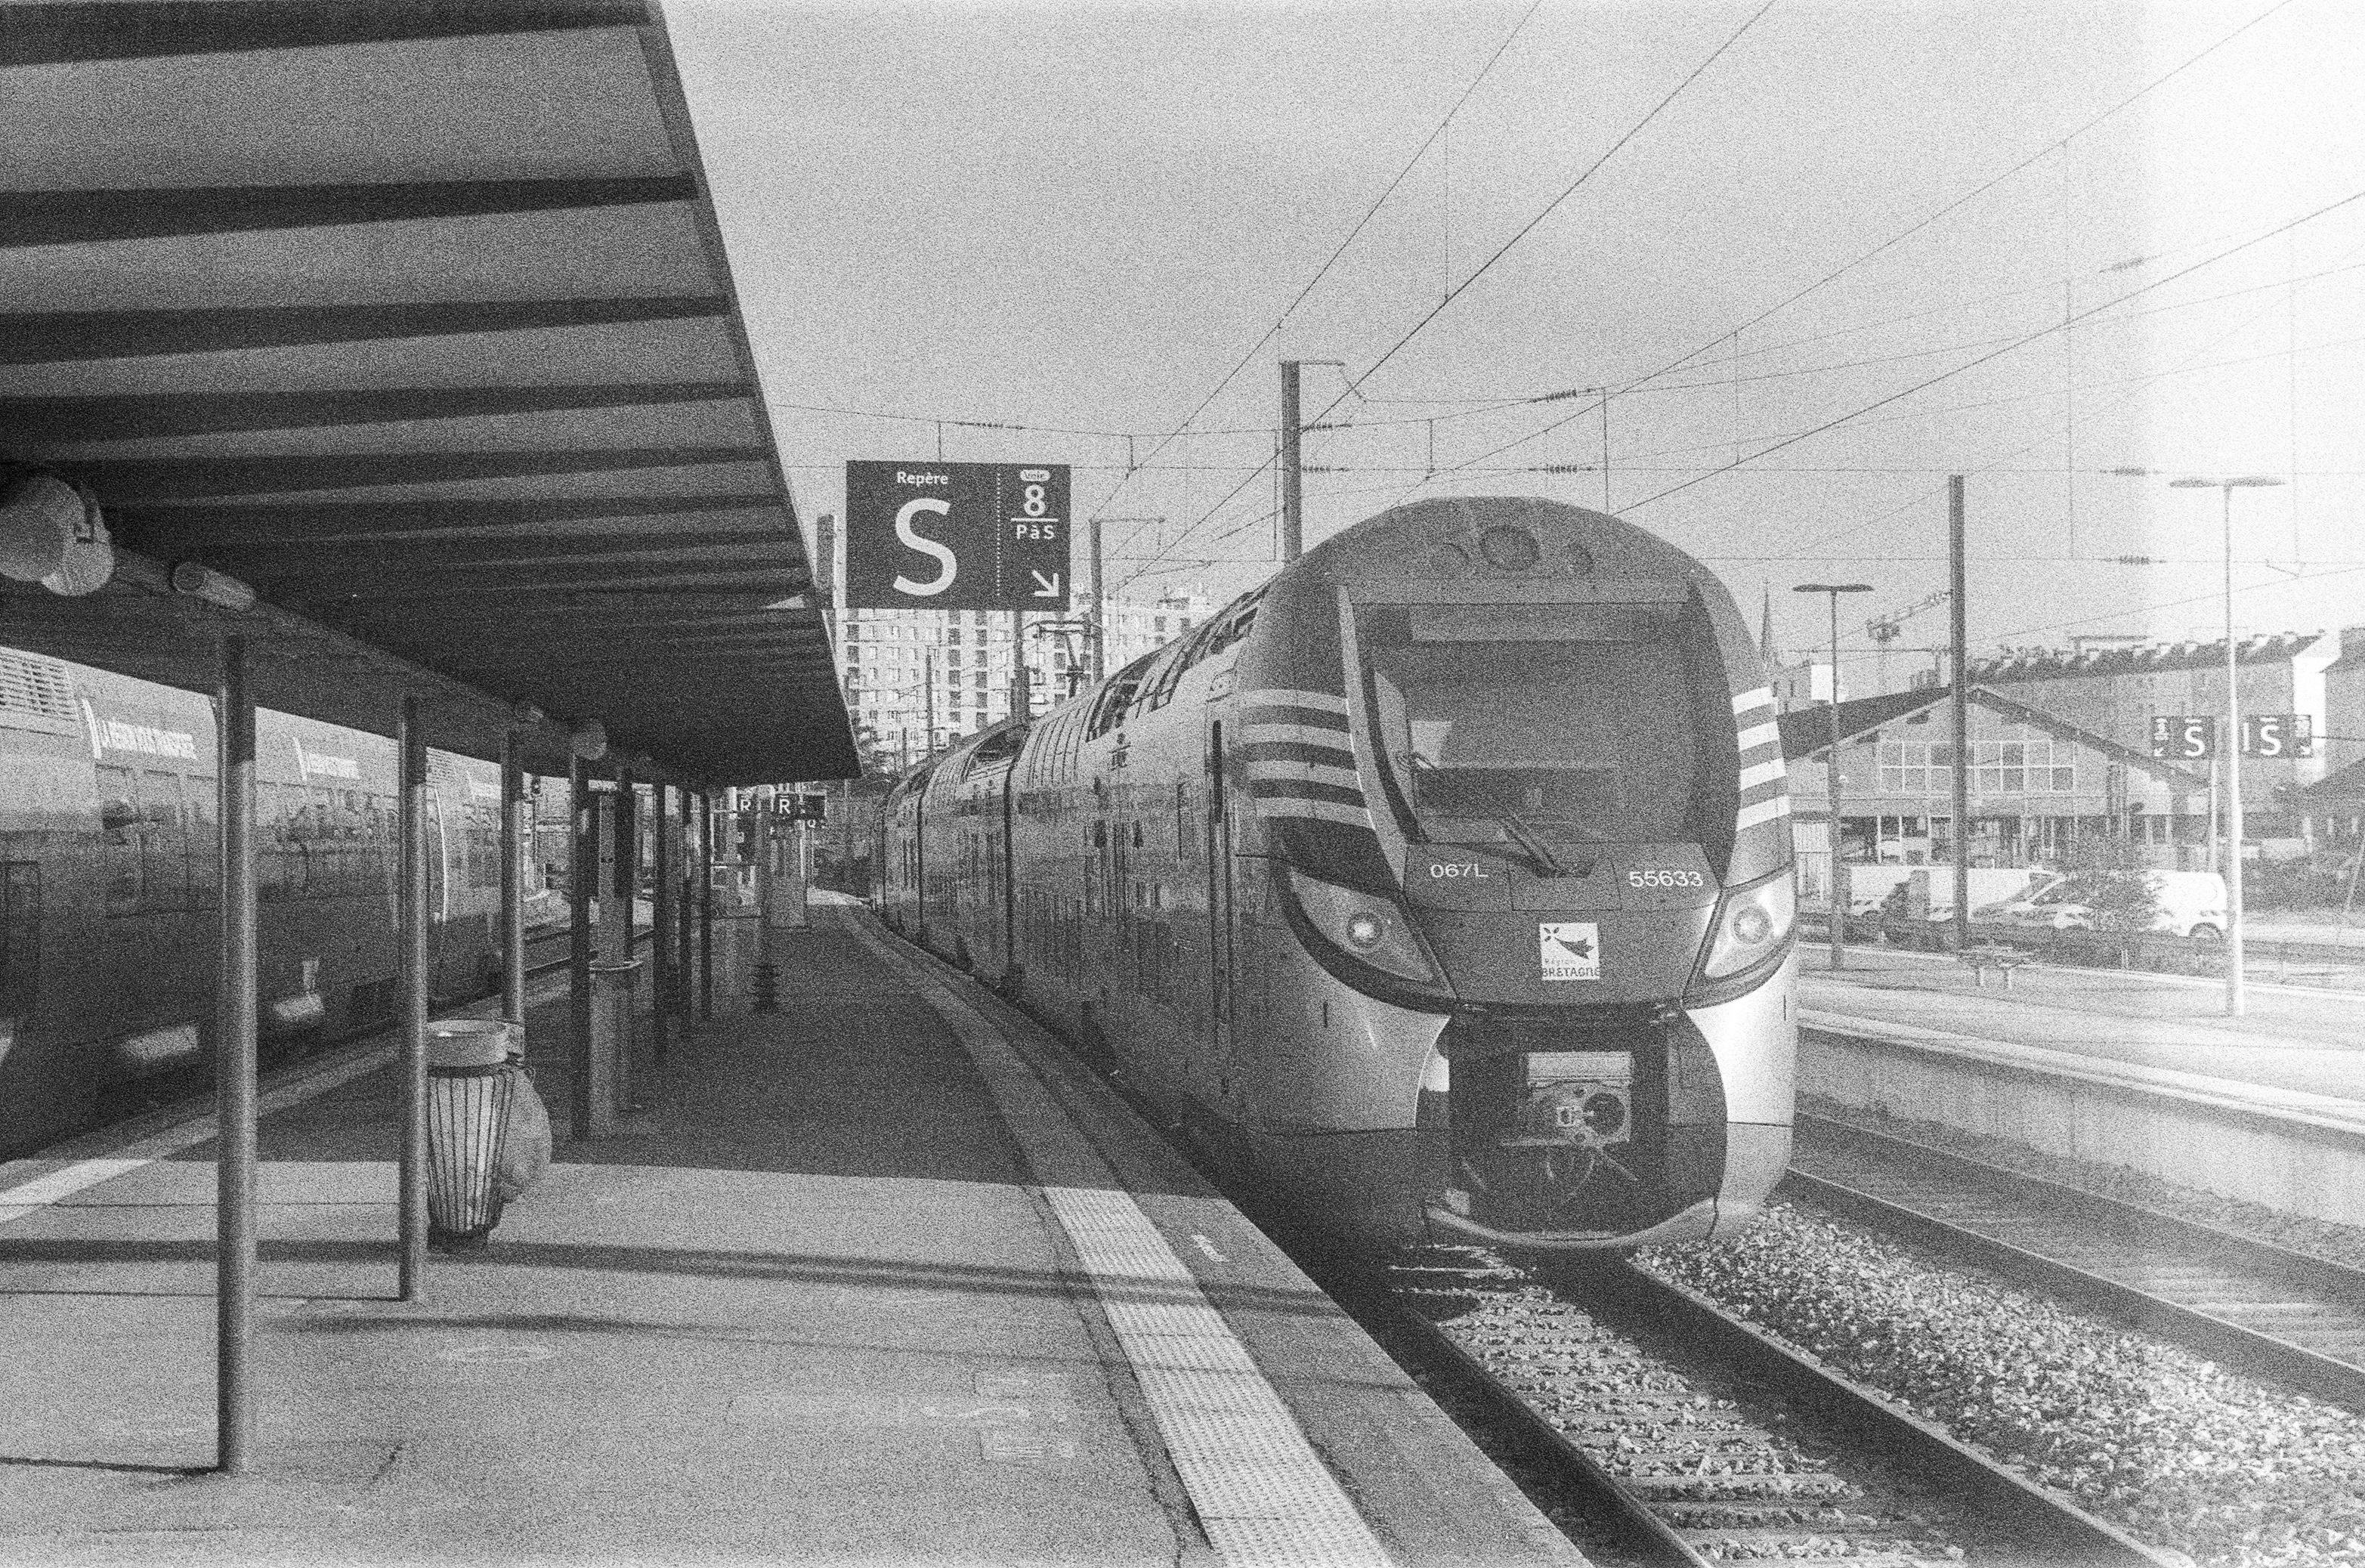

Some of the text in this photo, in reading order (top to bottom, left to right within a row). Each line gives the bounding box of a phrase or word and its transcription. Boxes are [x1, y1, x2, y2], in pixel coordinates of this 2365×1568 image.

[897, 472, 948, 486] Repère
[1024, 484, 1046, 517] 8
[893, 498, 957, 595] S
[2184, 726, 2206, 756] S
[2260, 725, 2282, 756] S
[740, 799, 751, 812] R
[779, 799, 791, 814] R
[1430, 864, 1489, 879] 067L
[1629, 871, 1703, 887] 55633
[1542, 966, 1600, 977] BRETAGNE
